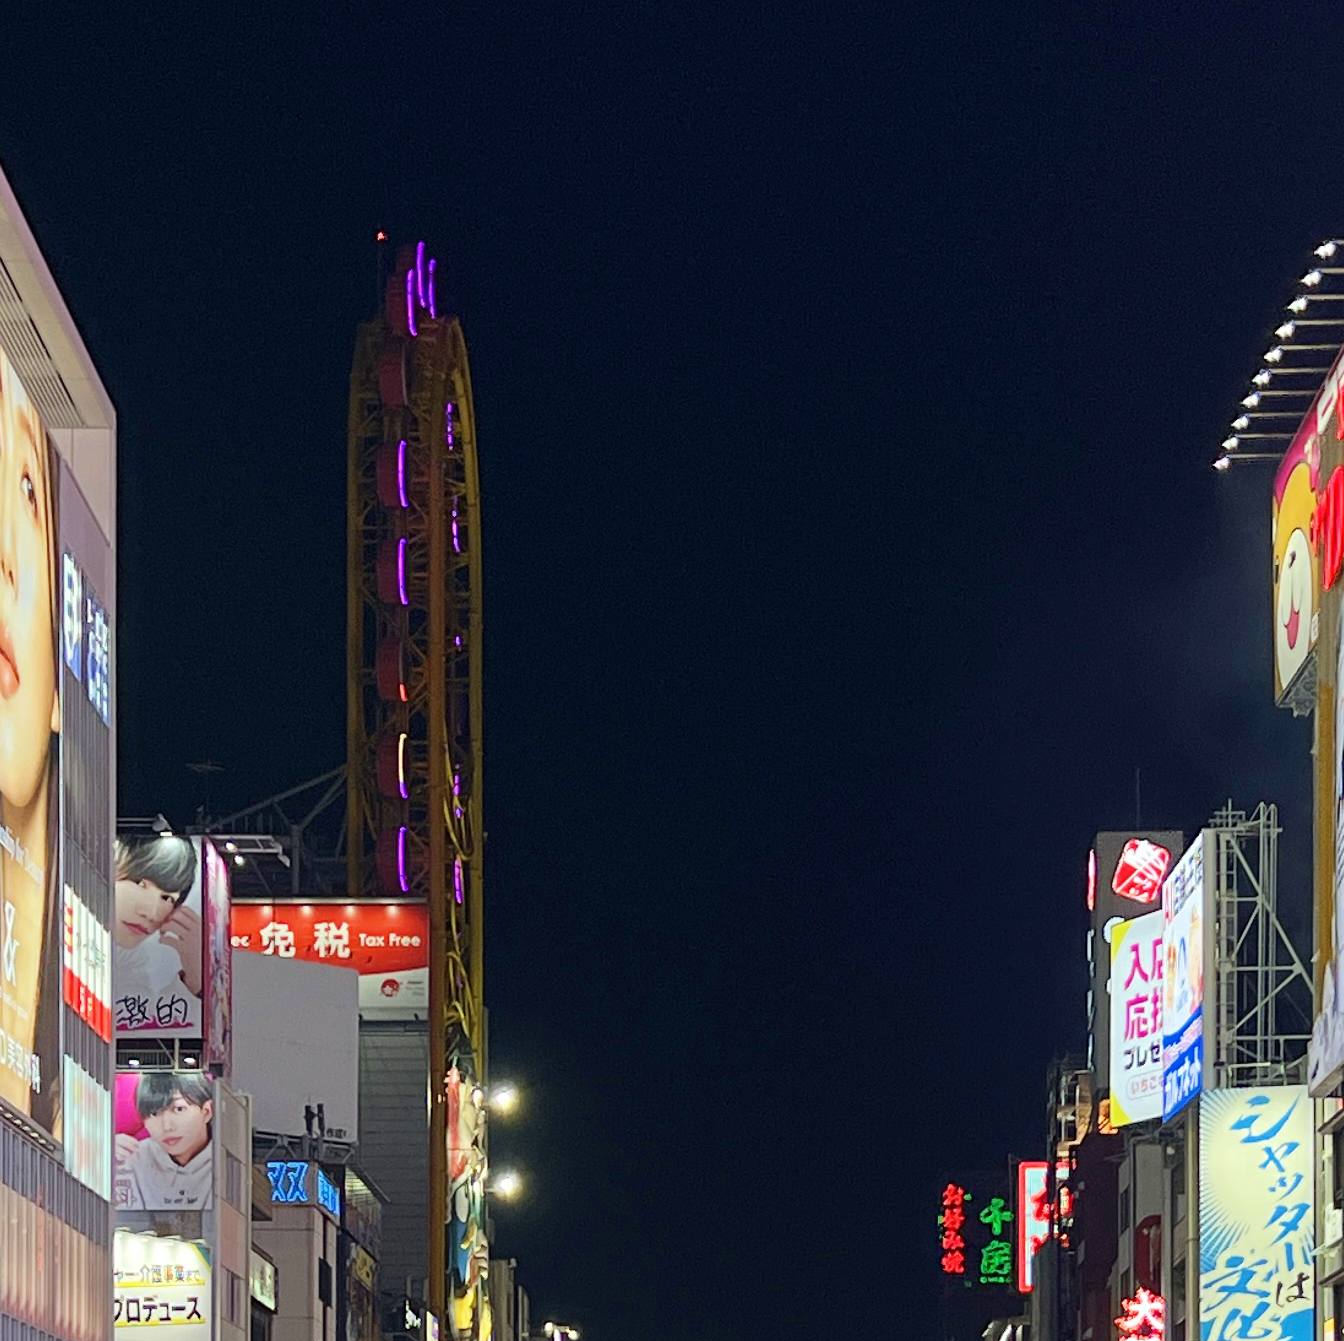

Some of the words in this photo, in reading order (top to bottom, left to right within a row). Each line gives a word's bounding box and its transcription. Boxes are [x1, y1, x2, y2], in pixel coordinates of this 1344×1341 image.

[260, 922, 350, 958] 免税
[359, 933, 384, 948] Tax
[389, 933, 422, 948] Free
